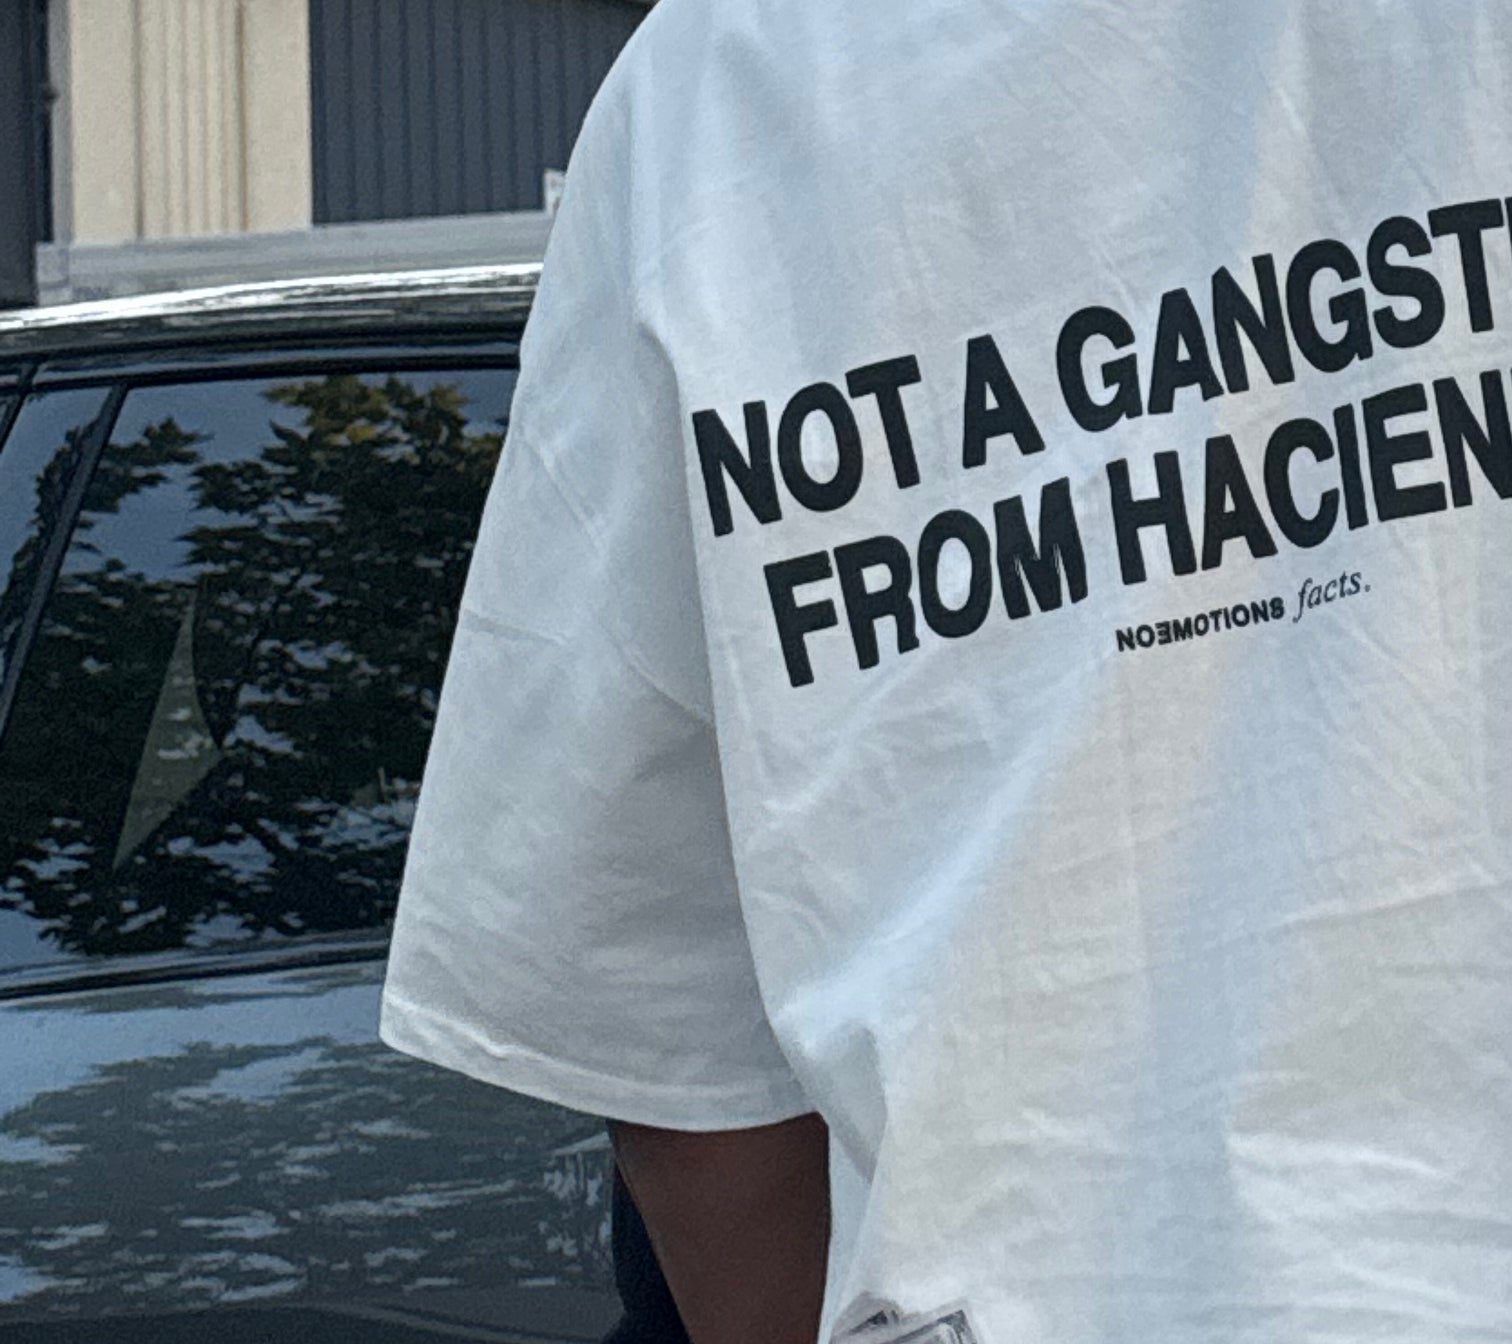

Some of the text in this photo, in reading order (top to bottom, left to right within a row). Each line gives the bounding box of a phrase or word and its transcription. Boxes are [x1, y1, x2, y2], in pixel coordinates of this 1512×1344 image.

[691, 354, 922, 537] NOT
[961, 334, 1045, 469] A
[763, 476, 1088, 688] FROM
[1292, 571, 1371, 623] facts.
